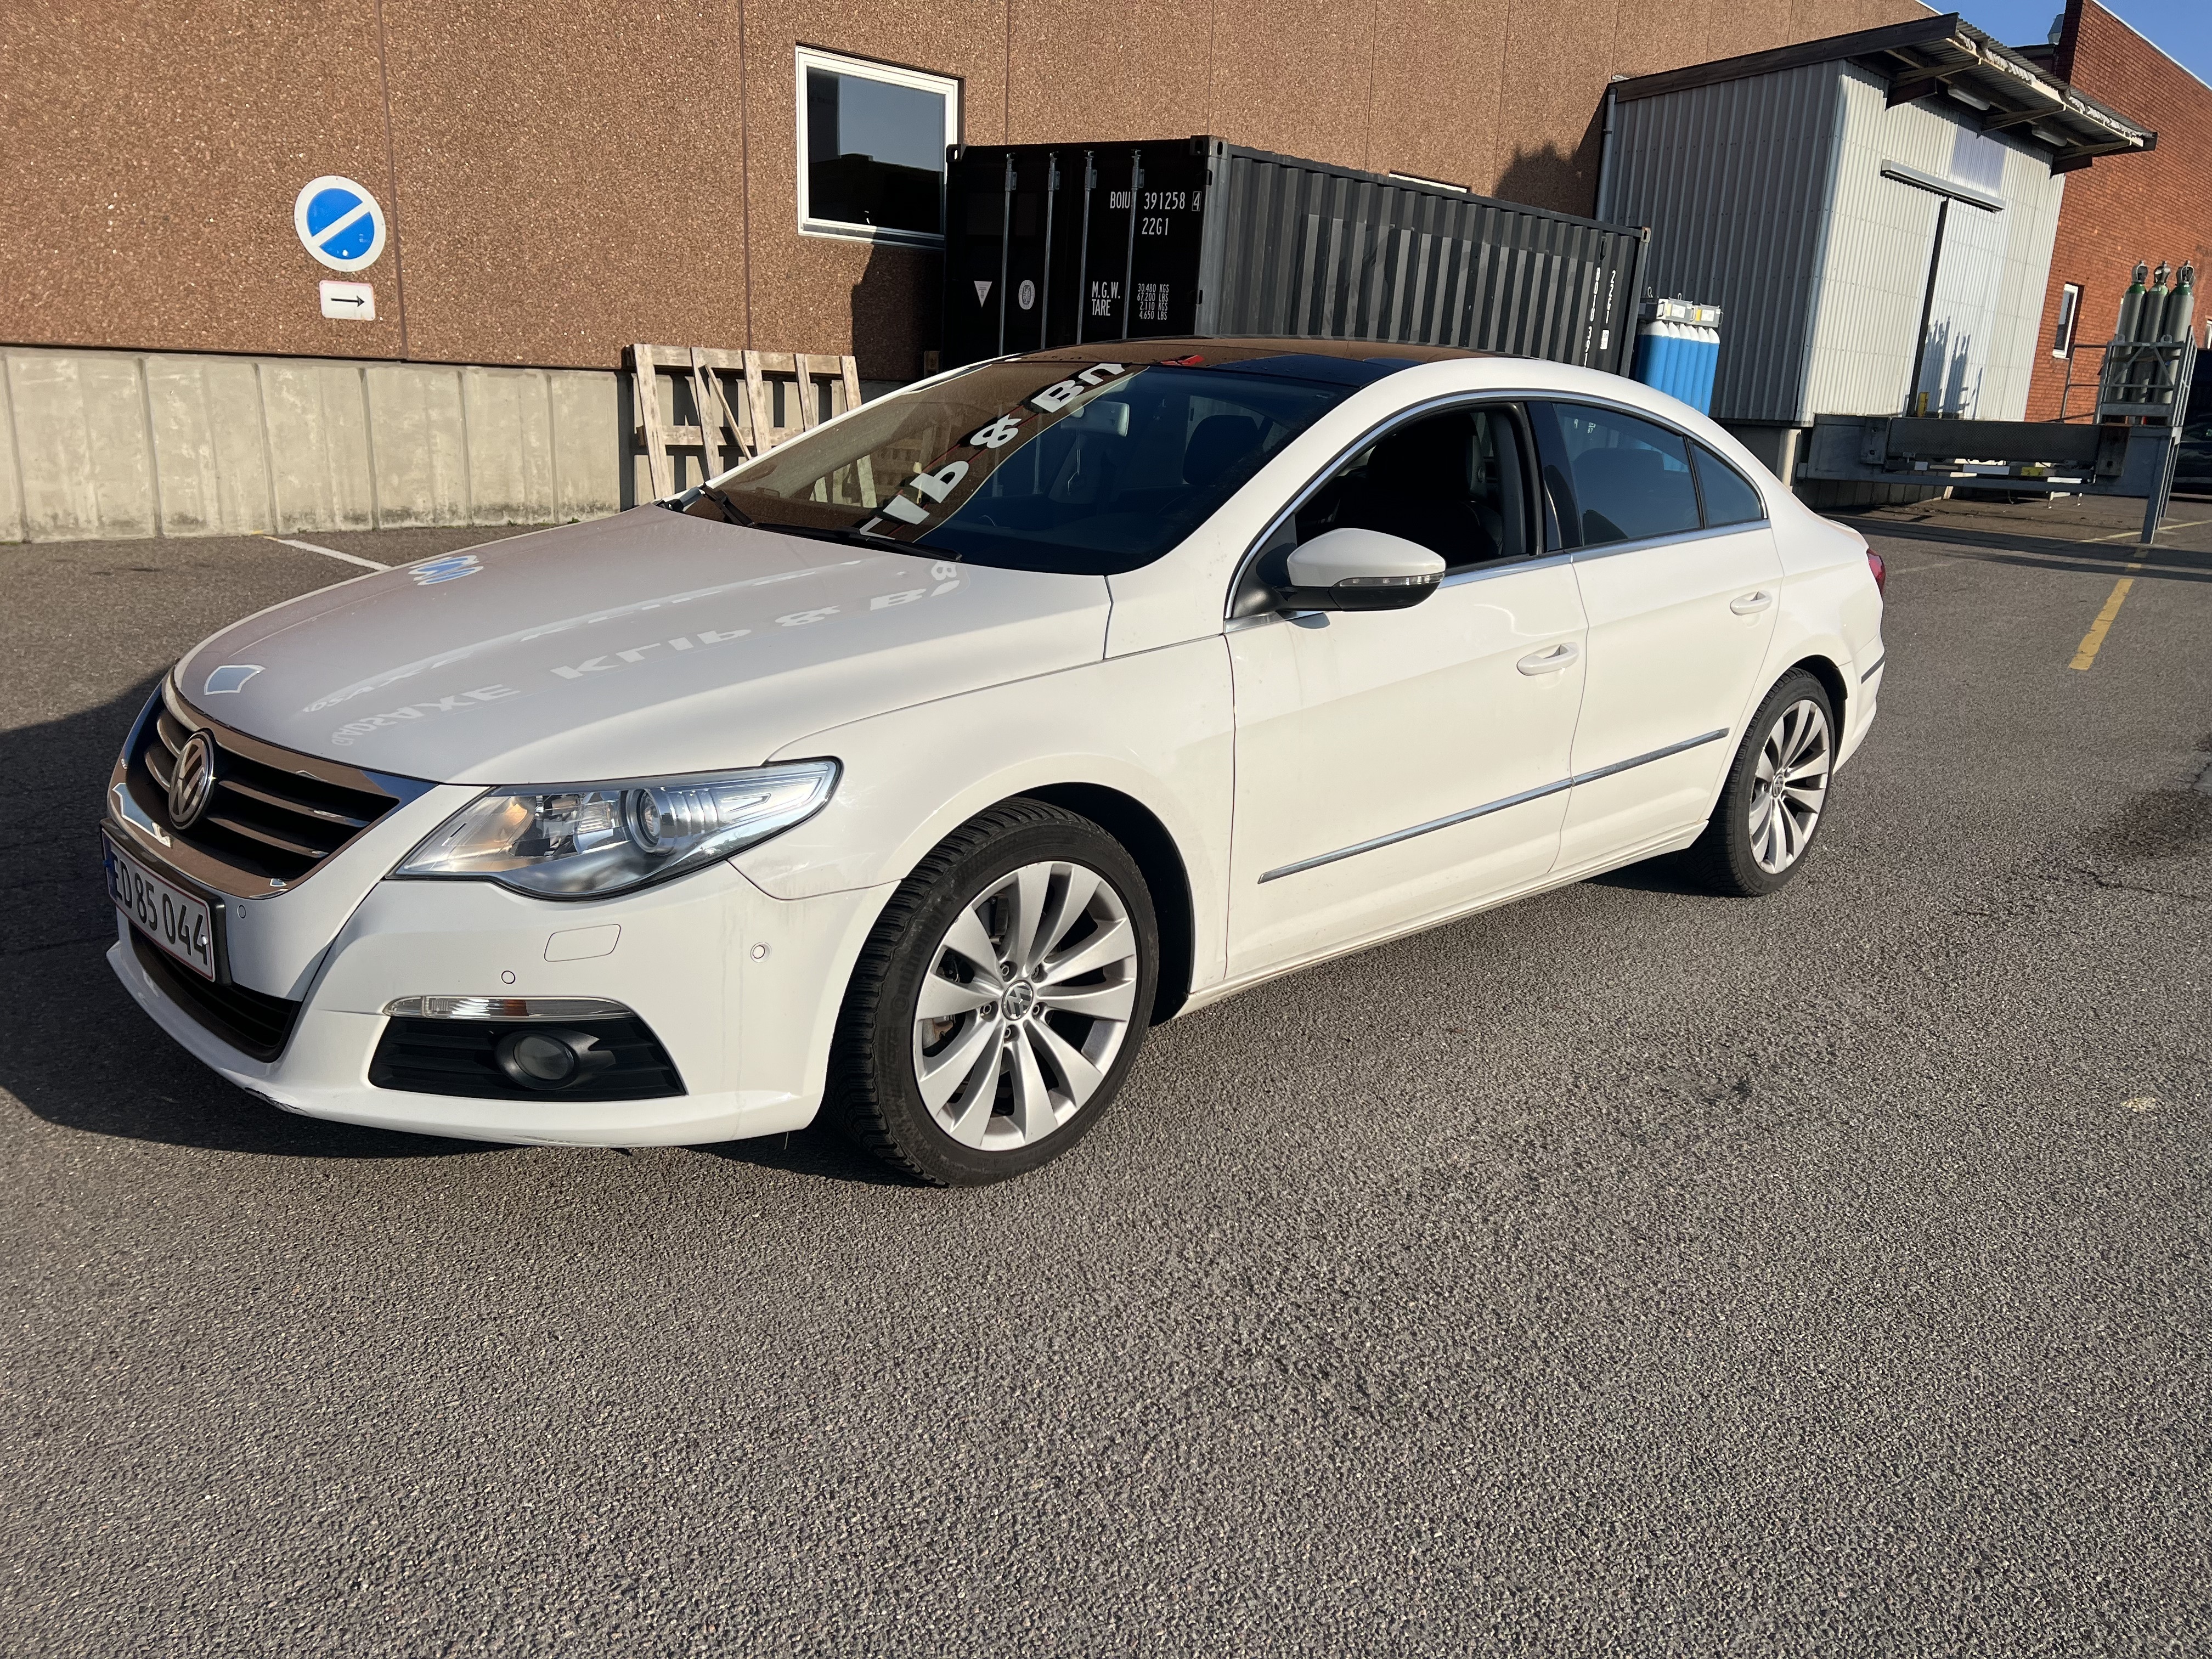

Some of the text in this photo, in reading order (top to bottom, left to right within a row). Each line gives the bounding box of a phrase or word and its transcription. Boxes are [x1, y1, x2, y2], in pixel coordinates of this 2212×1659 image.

[1109, 191, 1201, 211] BOIU 391258 4
[1142, 217, 1169, 236] 22G1
[1091, 281, 1121, 298] M.G.W.
[1159, 284, 1170, 293] KGS
[1159, 293, 1169, 302] LBS
[1605, 269, 1616, 324] 22G1
[1092, 298, 1111, 317] TARE
[1158, 302, 1168, 311] KGS
[1157, 311, 1167, 320] LBS
[1583, 267, 1601, 369] BOIU 391
[110, 850, 208, 966] ED 85 044
